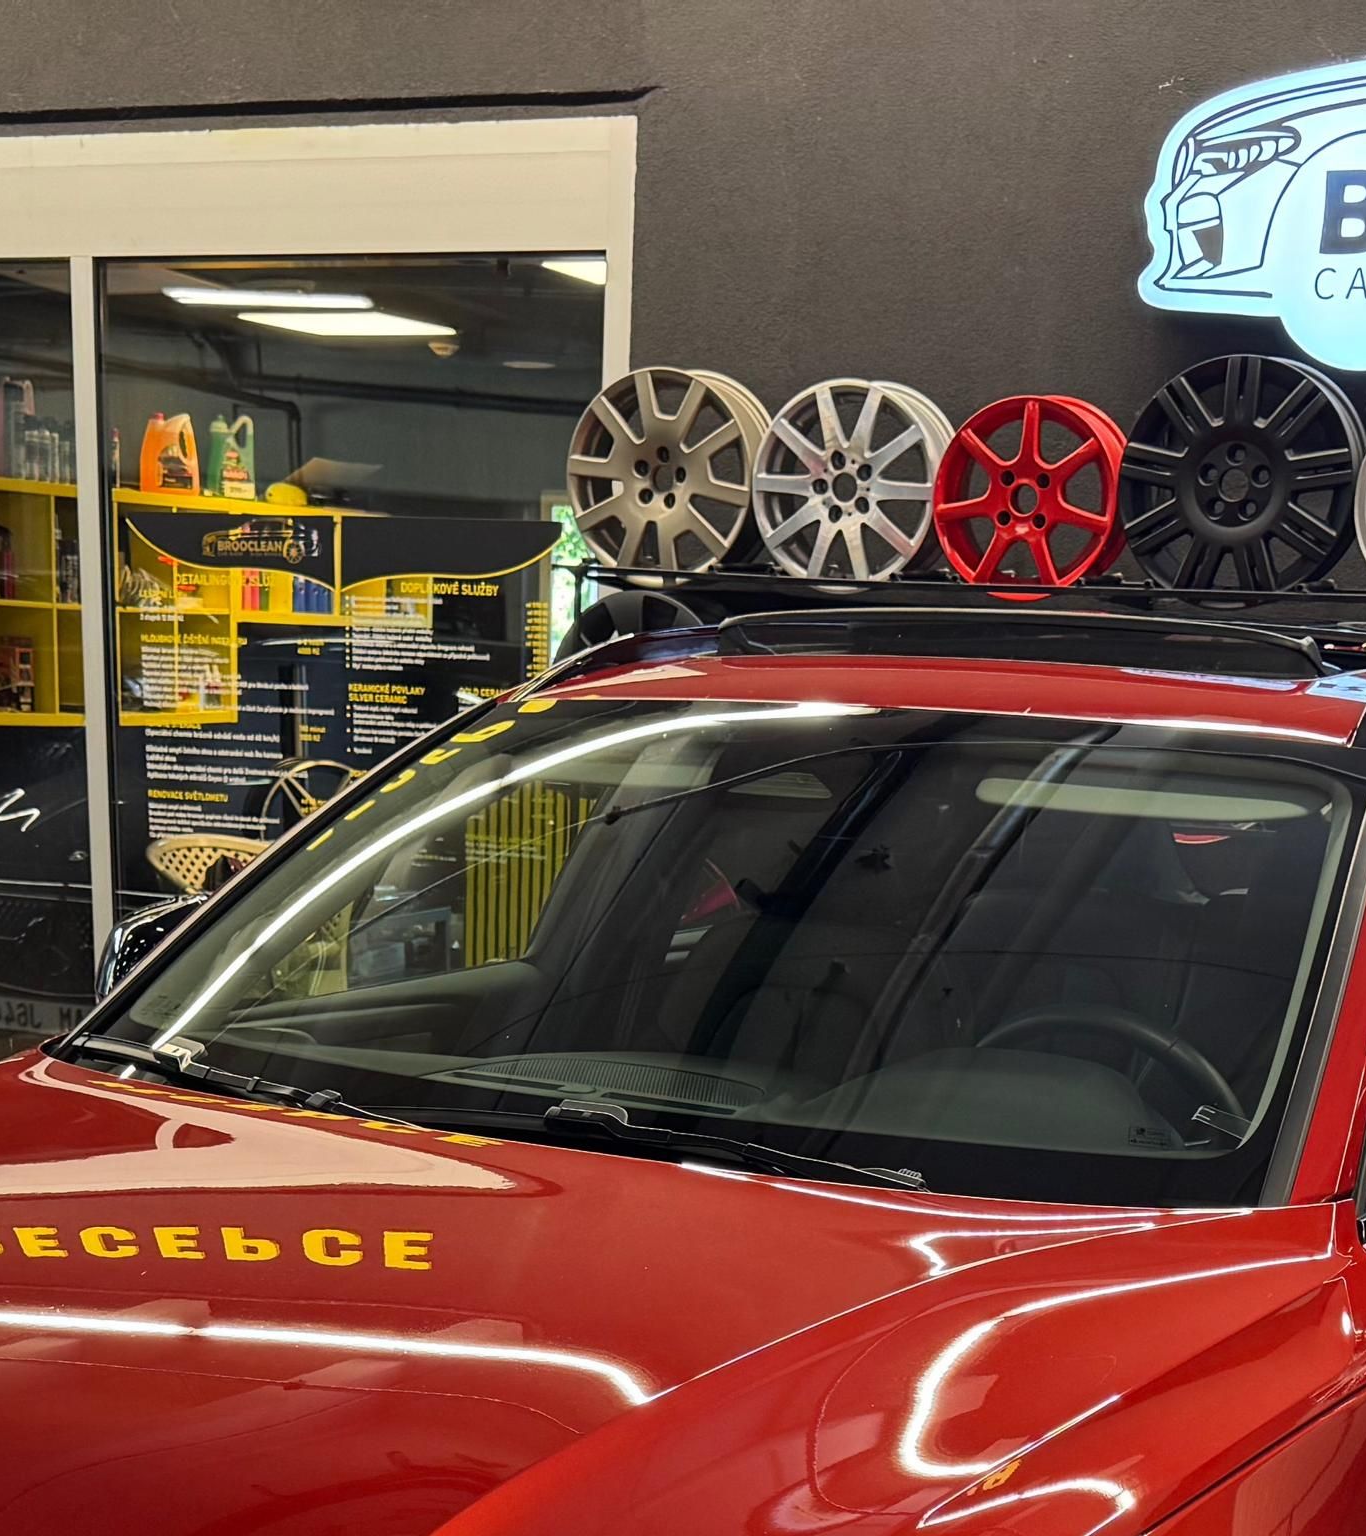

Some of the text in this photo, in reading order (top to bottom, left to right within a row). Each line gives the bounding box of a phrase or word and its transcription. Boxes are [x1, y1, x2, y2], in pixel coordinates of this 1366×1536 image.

[217, 541, 283, 552] BROOCLEAN
[461, 581, 499, 597] SLUŽBY
[348, 682, 426, 696] KERAMICKÉ POVLAKY
[348, 693, 408, 704] SILVER CERAMIC
[148, 789, 184, 801] RENOVACE
